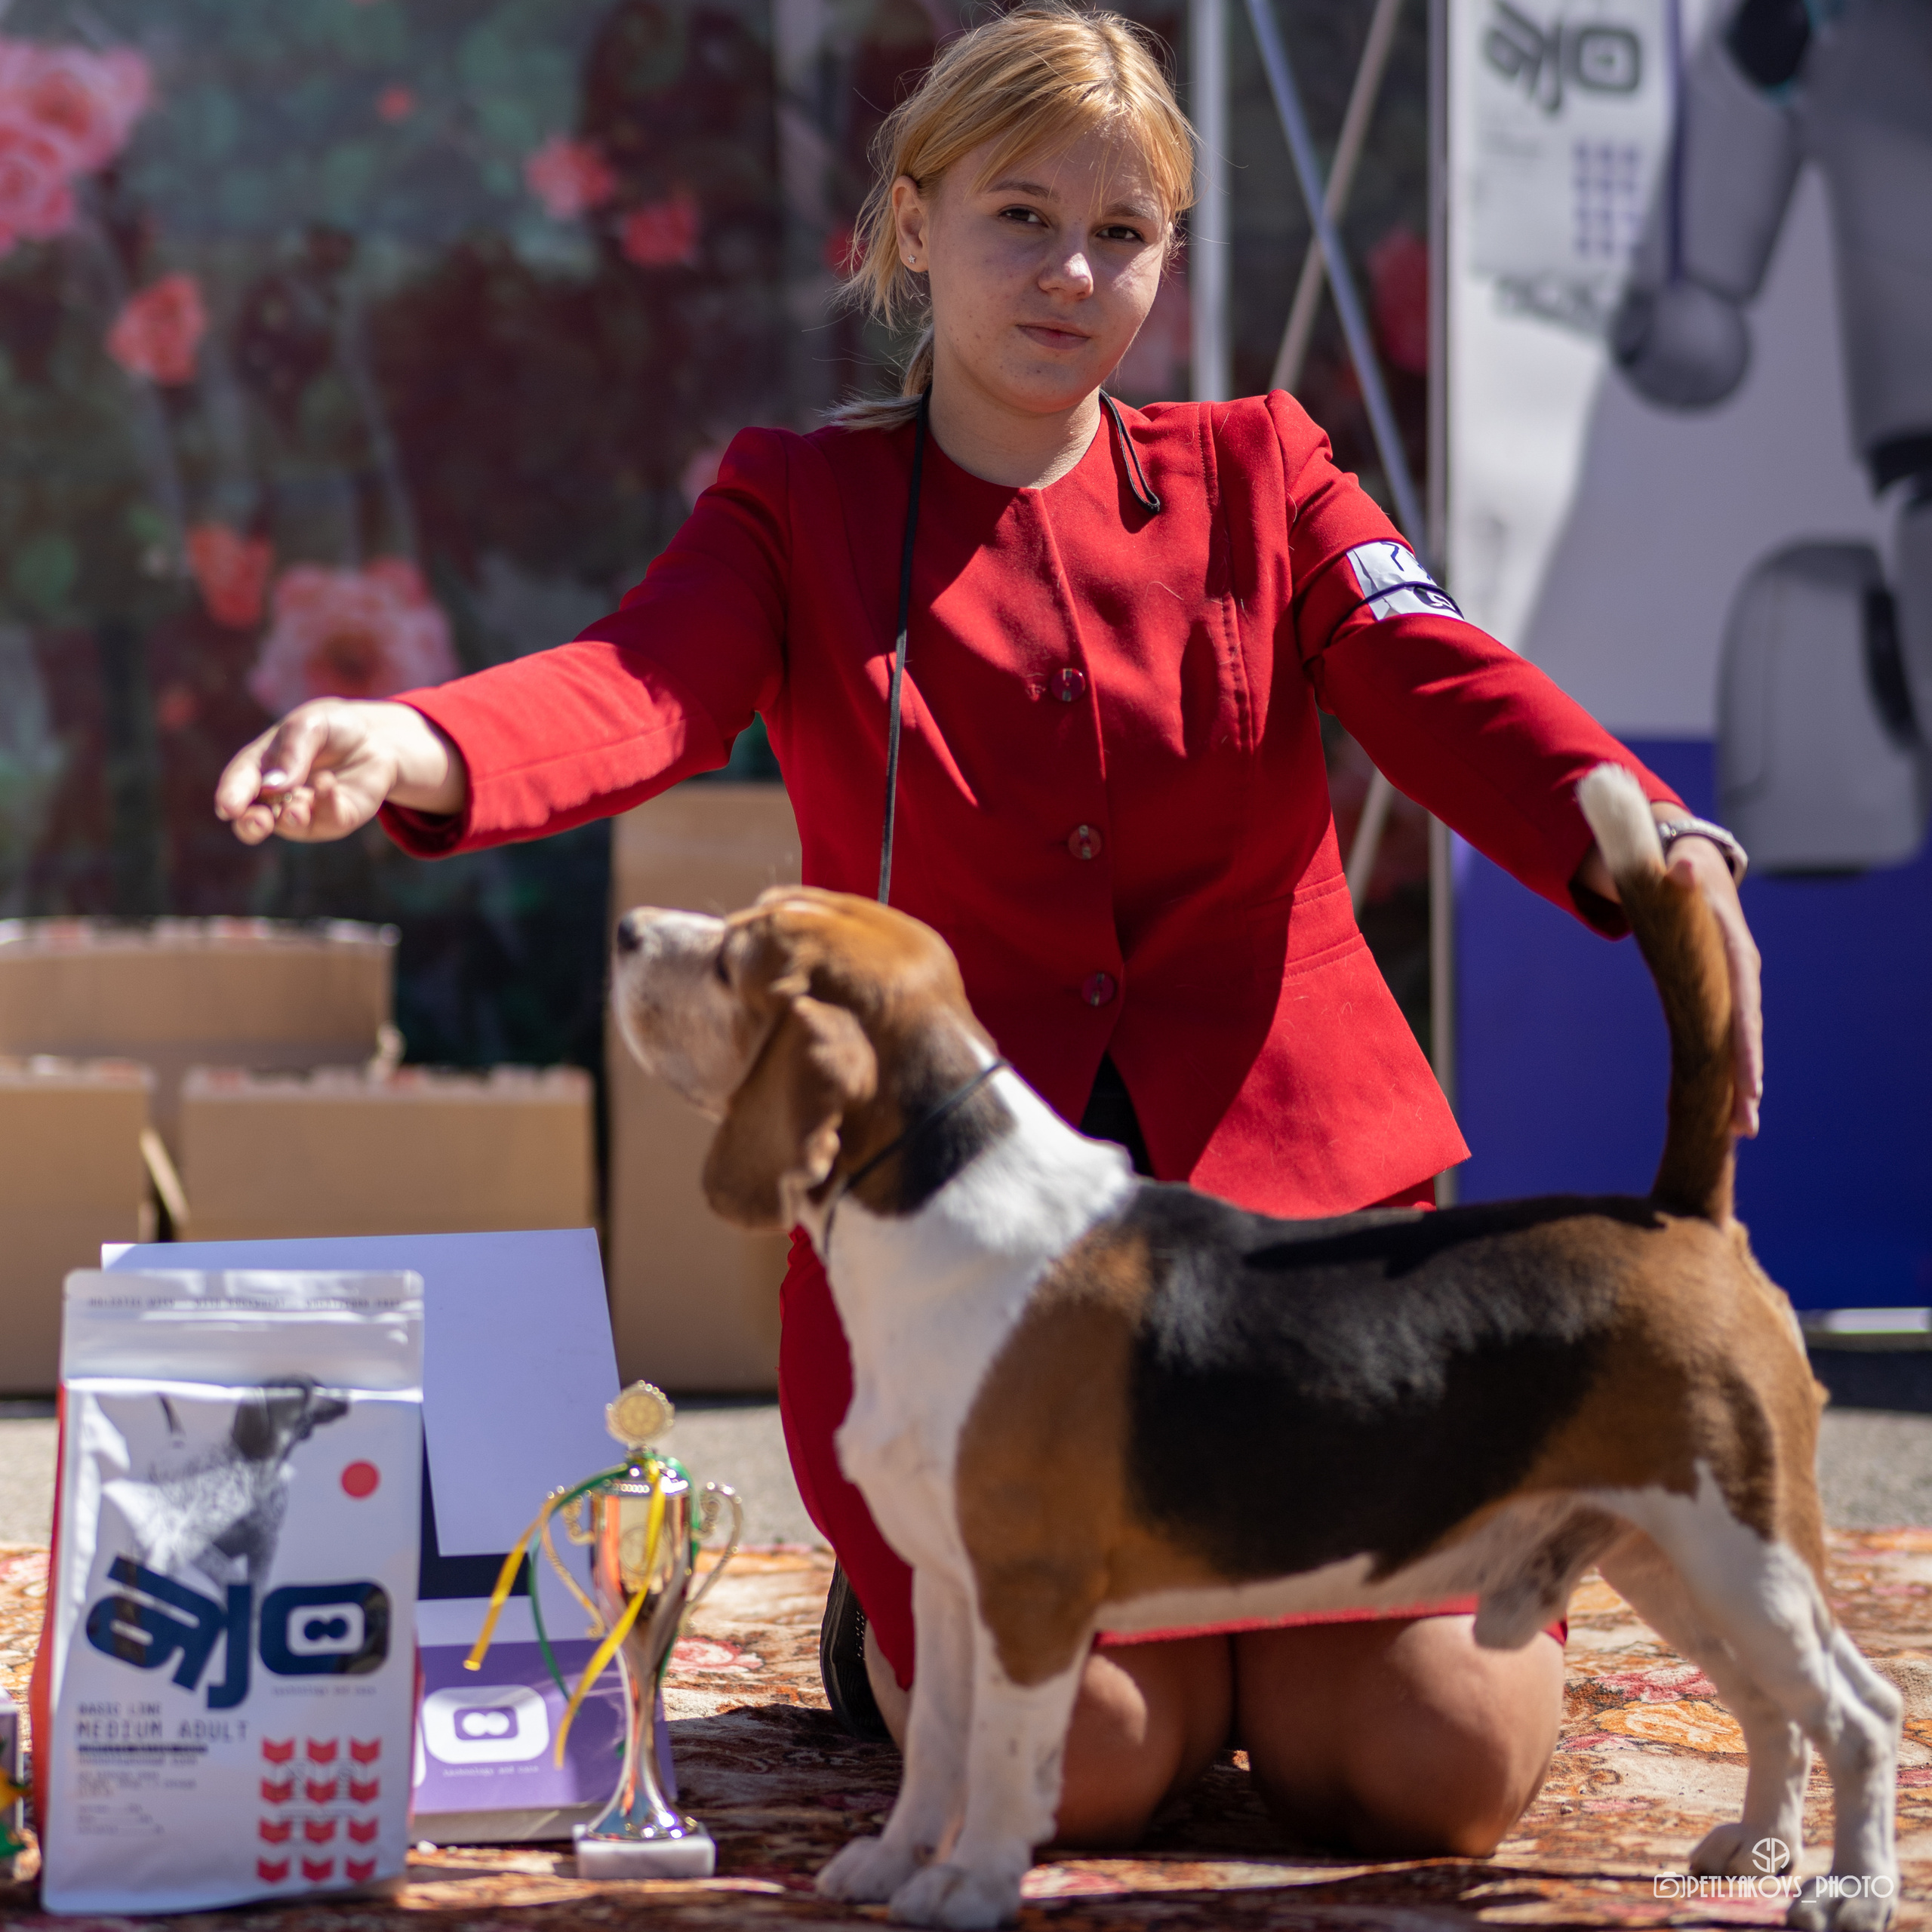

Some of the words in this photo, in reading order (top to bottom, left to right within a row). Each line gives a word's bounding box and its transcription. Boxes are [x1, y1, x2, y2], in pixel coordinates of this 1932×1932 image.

[78, 1702, 118, 1715] BASIC
[128, 1702, 161, 1715] LINE
[78, 1720, 162, 1738] MEDIUM
[179, 1719, 248, 1742] ADULT
